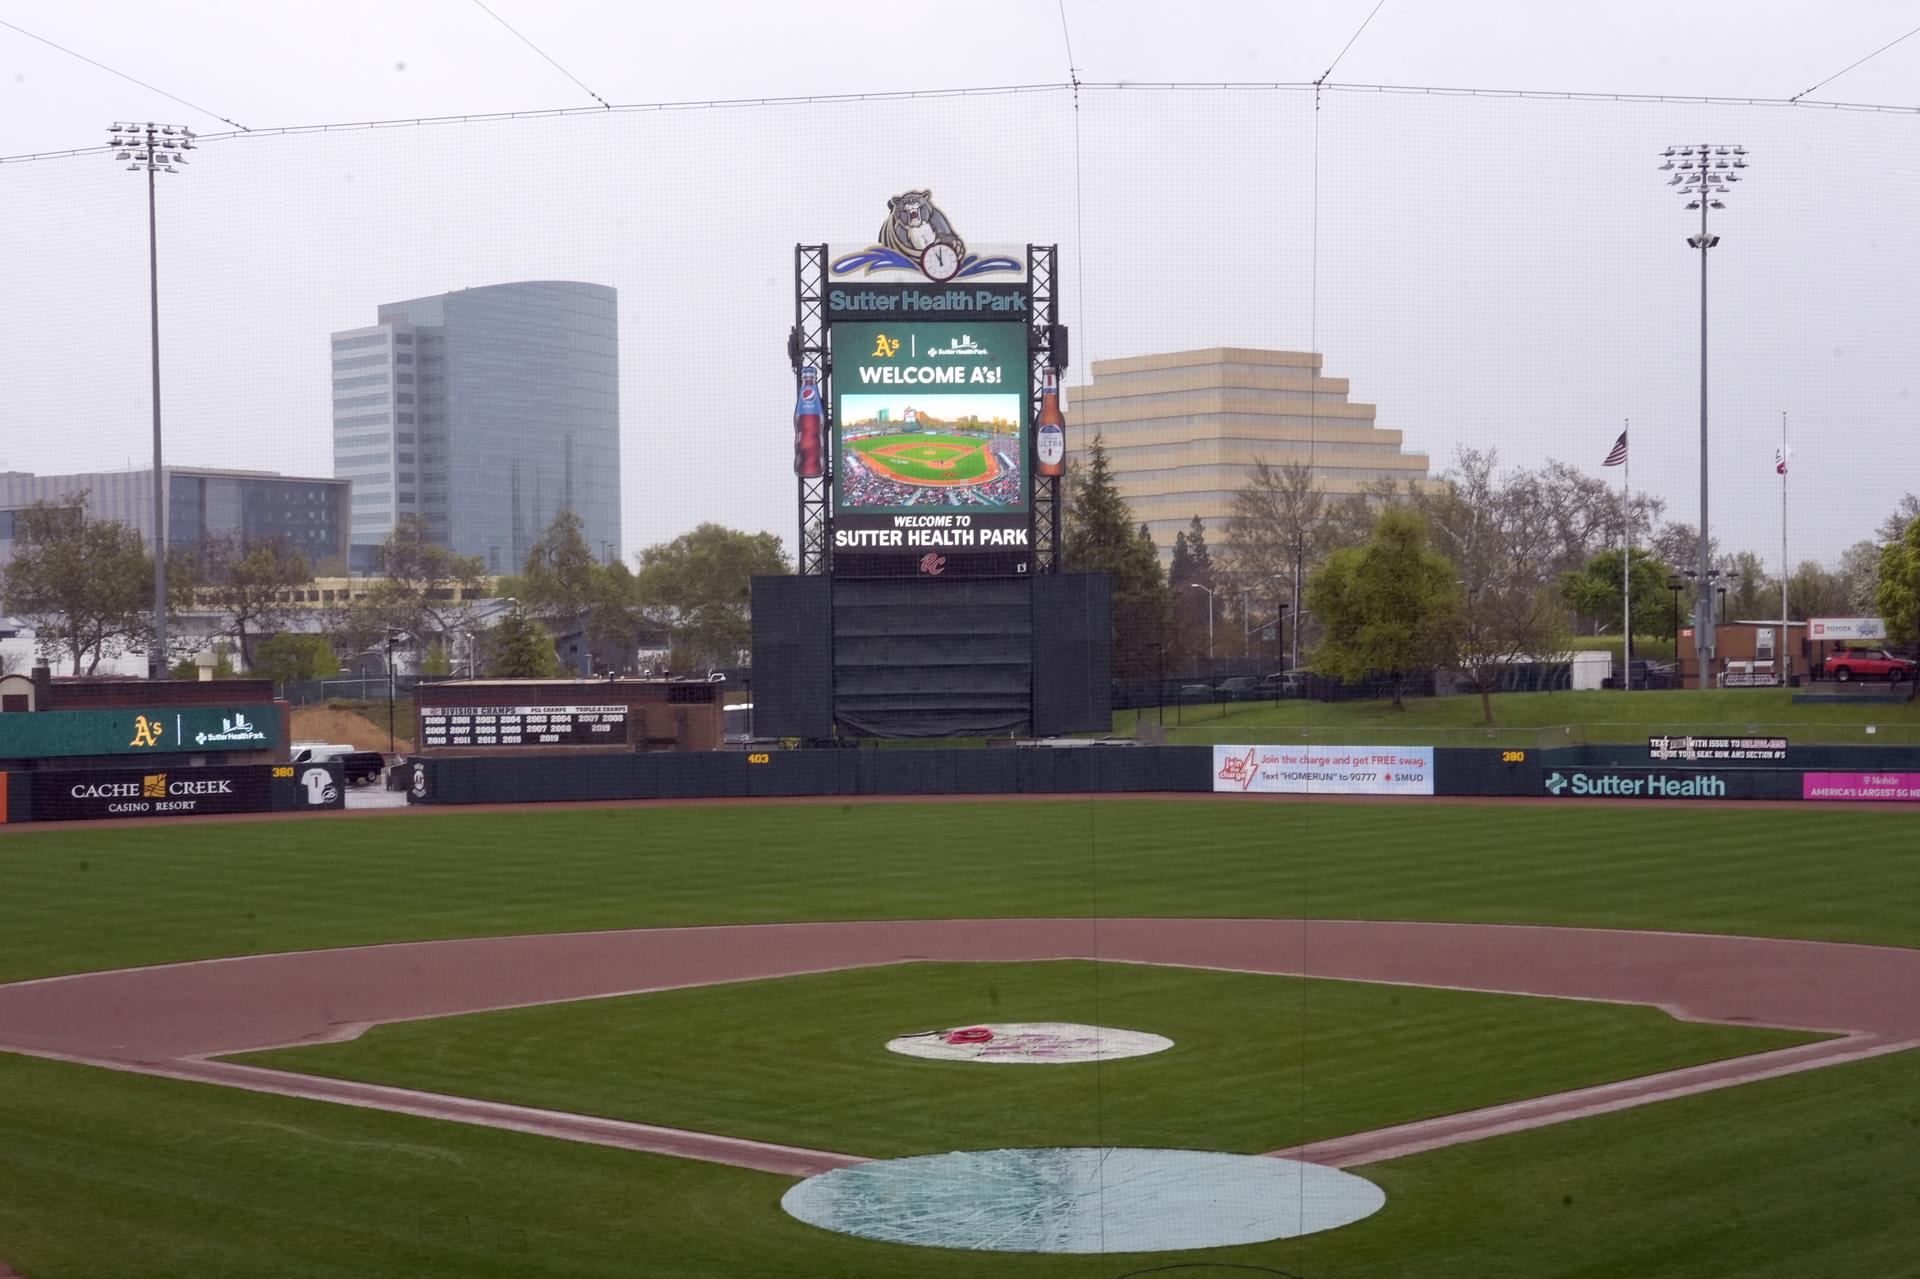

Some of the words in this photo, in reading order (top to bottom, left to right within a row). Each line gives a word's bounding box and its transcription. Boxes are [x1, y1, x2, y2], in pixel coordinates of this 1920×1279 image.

[830, 290, 900, 310] Sutter
[902, 291, 974, 310] Health
[976, 291, 1028, 310] Park
[872, 334, 900, 358] A's
[859, 366, 966, 384] WELCOME
[970, 366, 1002, 384] A's!
[894, 516, 952, 527] WELCOME
[956, 515, 970, 526] TO
[835, 530, 902, 546] SUTTER
[908, 530, 974, 546] HEALTH
[980, 529, 1028, 546] PARK
[920, 552, 946, 575] RC
[129, 715, 162, 746] A's
[207, 733, 228, 741] Sutter
[228, 732, 249, 740] Health
[249, 732, 264, 740] Park
[748, 754, 769, 764] 403
[1261, 755, 1279, 764] Join
[1282, 755, 1297, 764] the
[1299, 755, 1330, 767] charge
[1332, 756, 1350, 765] and
[1353, 757, 1368, 767] get
[1371, 756, 1396, 765] FREE
[1399, 758, 1426, 767] swag.
[1502, 752, 1524, 762] 380
[272, 768, 294, 777] 380
[1395, 774, 1424, 782] SMUD
[314, 776, 318, 788] 1
[1571, 773, 1644, 794] Sutter
[1648, 775, 1725, 796] Health
[71, 784, 140, 798] CACHE
[169, 780, 232, 795] CREEK
[1811, 788, 1857, 796] AMERICA'S
[1858, 788, 1895, 797] LARGEST
[1897, 789, 1908, 797] 5G
[108, 802, 150, 812] CASINO
[156, 801, 196, 811] RESORT
